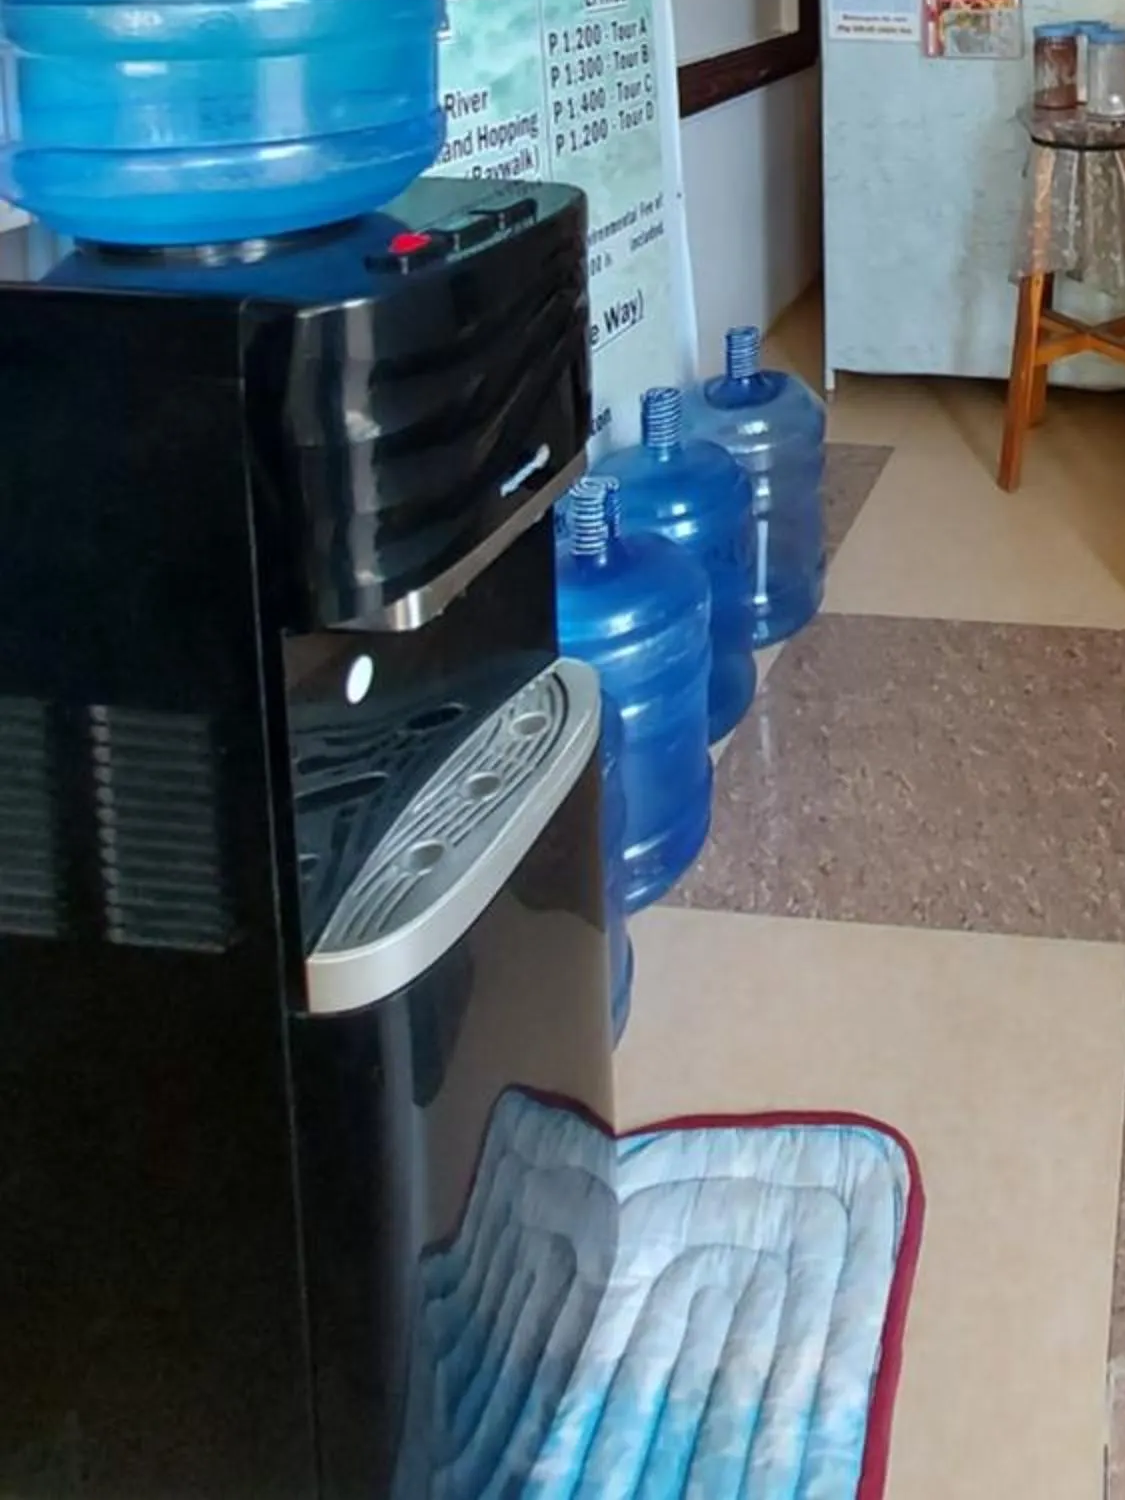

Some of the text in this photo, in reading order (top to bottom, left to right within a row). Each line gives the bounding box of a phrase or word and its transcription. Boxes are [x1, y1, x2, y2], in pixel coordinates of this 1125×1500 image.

[548, 31, 559, 56] P
[611, 19, 637, 43] Tour
[638, 16, 648, 35] A
[550, 65, 561, 89] P
[612, 49, 639, 71] Tour
[640, 43, 649, 65] B
[443, 89, 489, 120] River
[553, 100, 563, 125] P
[616, 80, 642, 103] Tour
[643, 72, 653, 94] C
[476, 110, 540, 150] Hopping
[555, 133, 565, 158] P
[618, 107, 644, 132] Tour
[603, 288, 644, 333] Way)
